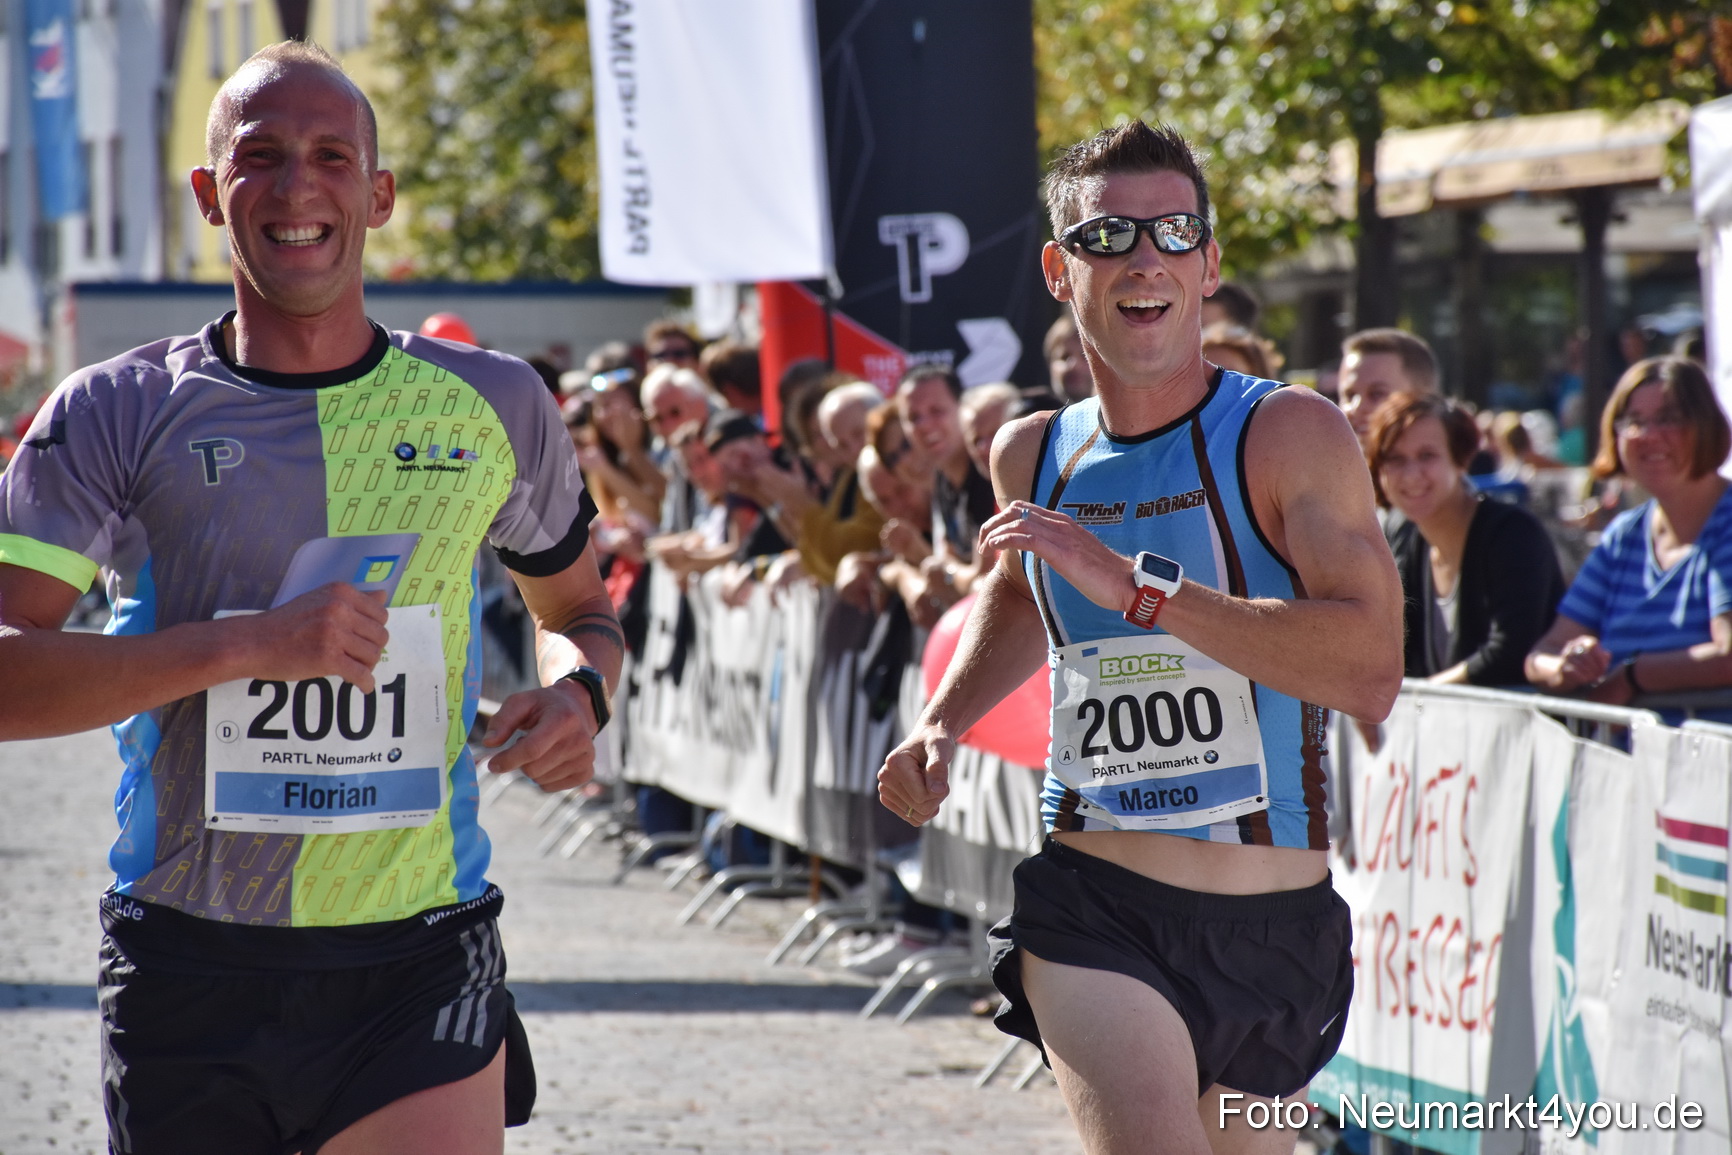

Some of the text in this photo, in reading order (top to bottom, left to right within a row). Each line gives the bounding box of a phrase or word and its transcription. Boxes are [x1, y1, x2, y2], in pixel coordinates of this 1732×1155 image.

[423, 465, 465, 473] NEUMARKT
[1170, 488, 1207, 513] RACER
[1100, 653, 1186, 679] BOCK
[1100, 672, 1186, 687] inspired by smart concepts
[247, 673, 406, 742] 2001
[1077, 687, 1223, 759] 2000
[262, 751, 382, 766] PARTL Neumarkt
[1092, 755, 1200, 779] PARTL Neumarkt
[284, 781, 377, 810] Florian
[1119, 785, 1199, 812] Marco
